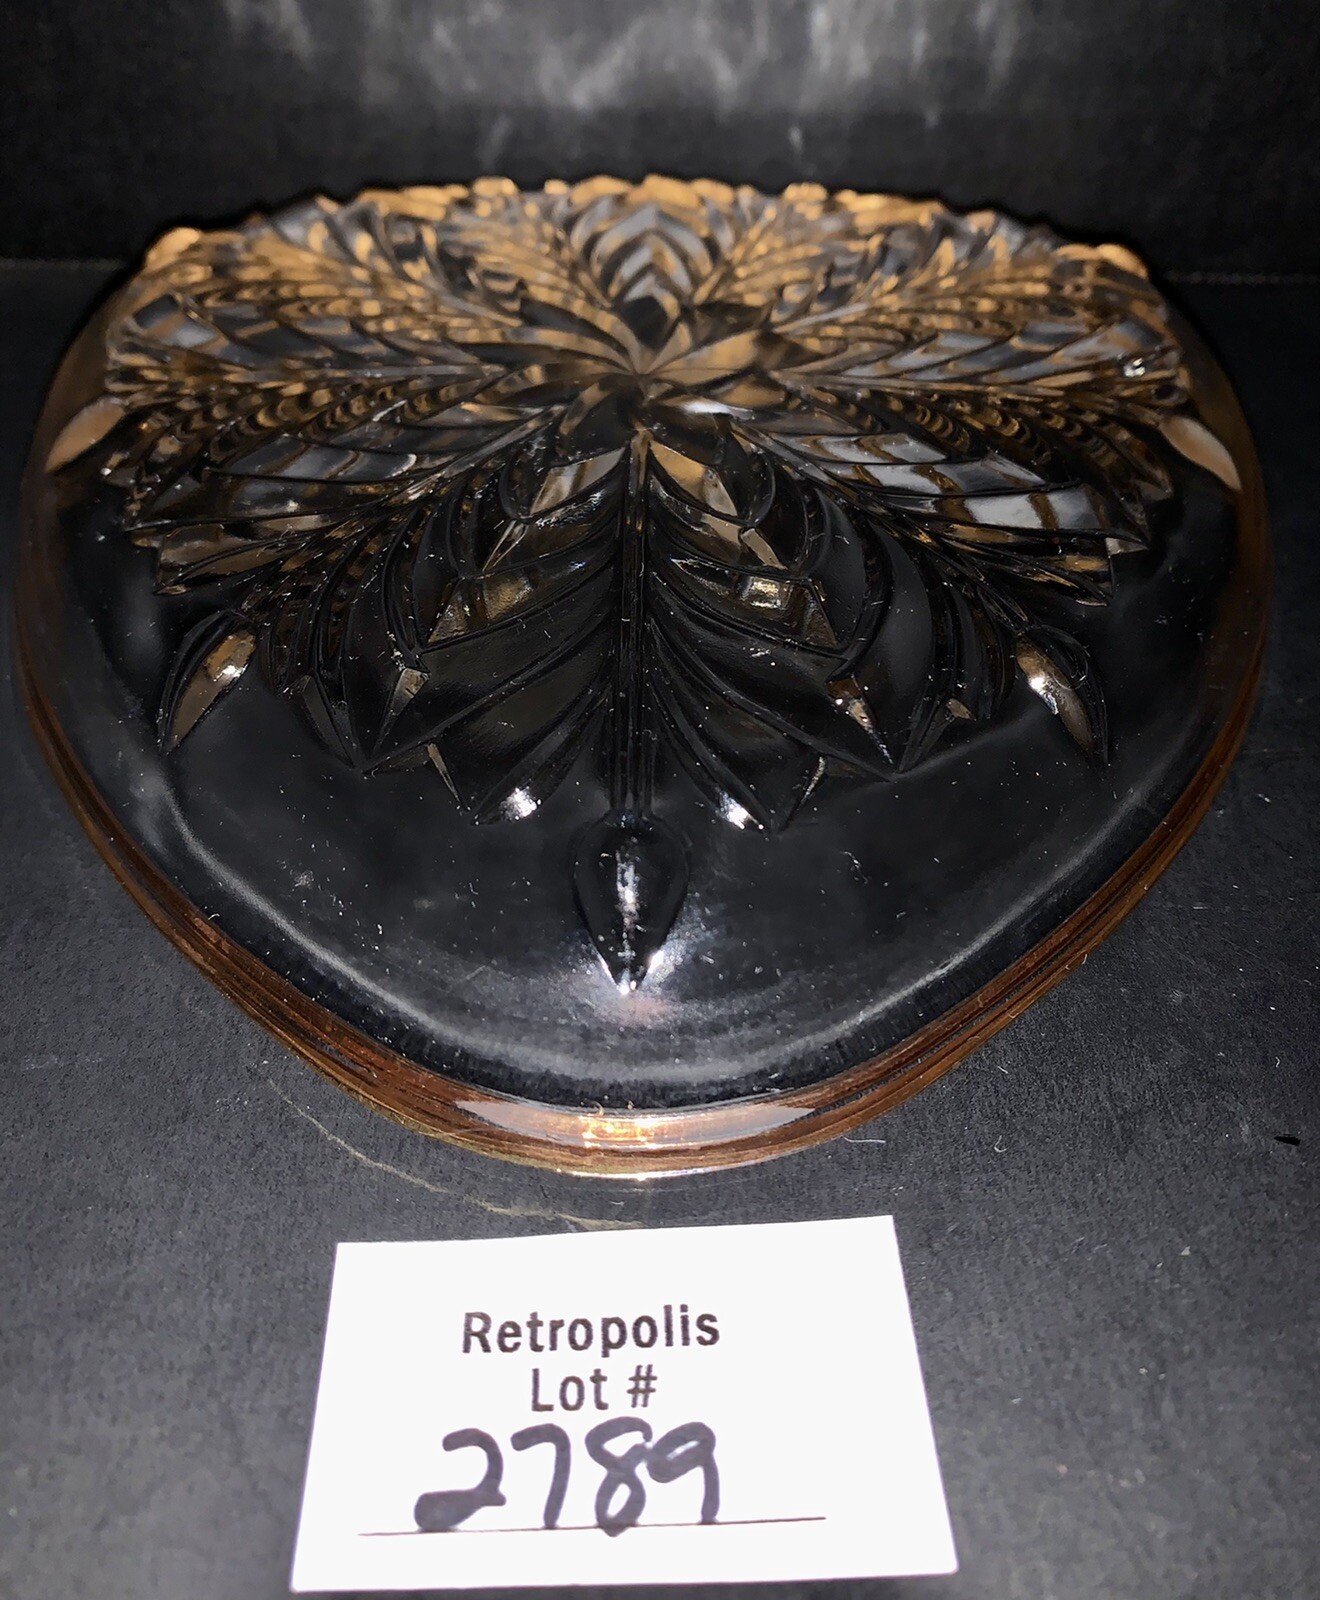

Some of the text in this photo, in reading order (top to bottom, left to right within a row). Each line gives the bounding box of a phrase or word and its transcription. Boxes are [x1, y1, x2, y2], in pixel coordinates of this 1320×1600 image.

[461, 1304, 721, 1358] Retropolis
[531, 1364, 658, 1412] Lot #
[413, 1415, 721, 1537] 2789
